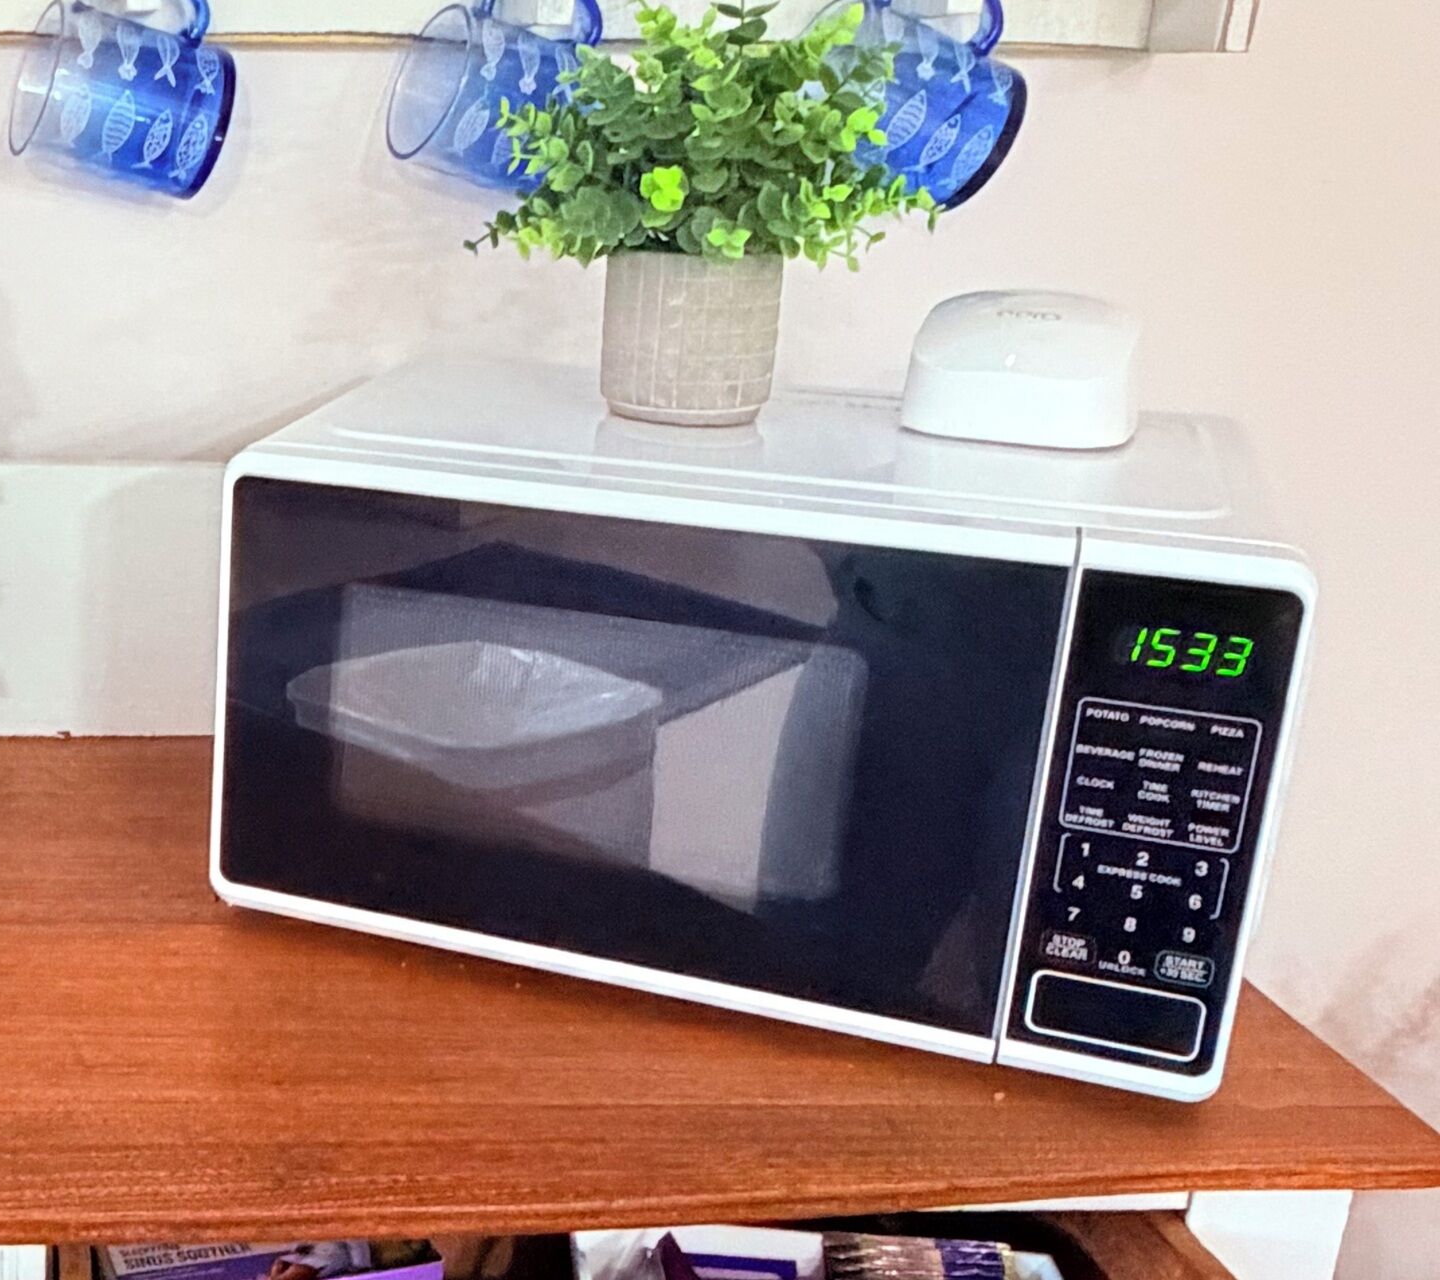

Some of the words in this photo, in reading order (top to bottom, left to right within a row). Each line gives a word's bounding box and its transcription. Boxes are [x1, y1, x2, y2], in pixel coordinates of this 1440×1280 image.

[1130, 627, 1255, 677] 1533
[1085, 707, 1130, 723] POTATO
[1139, 715, 1196, 732] POPCORN
[1210, 724, 1245, 739] PIZZA
[1076, 744, 1136, 761] BEVERAGE
[1139, 748, 1185, 762] FROZEN
[1076, 775, 1115, 790] CLOCK
[1137, 789, 1170, 804] COOK
[1190, 789, 1241, 804] KITCHEN
[1196, 799, 1231, 813] TIMER
[1065, 813, 1115, 829] DEFROST
[1122, 822, 1174, 838] DEFROST
[1188, 822, 1230, 837] POWER
[1189, 833, 1224, 847] LEVEL
[1081, 842, 1091, 857] 1
[1136, 851, 1150, 867] 2
[1097, 864, 1147, 883] EXPRESS
[1148, 872, 1182, 887] COOK
[1194, 860, 1209, 877] 3
[1071, 875, 1086, 890] 4
[1130, 884, 1143, 900] 5
[1188, 894, 1202, 910] 6
[1067, 907, 1081, 921] 7
[1123, 917, 1137, 933] 8
[1052, 933, 1086, 948] STOP
[1182, 927, 1196, 943] 9
[1045, 942, 1088, 961] CLEAR
[1164, 955, 1205, 970] START
[123, 1252, 175, 1270] SINUS
